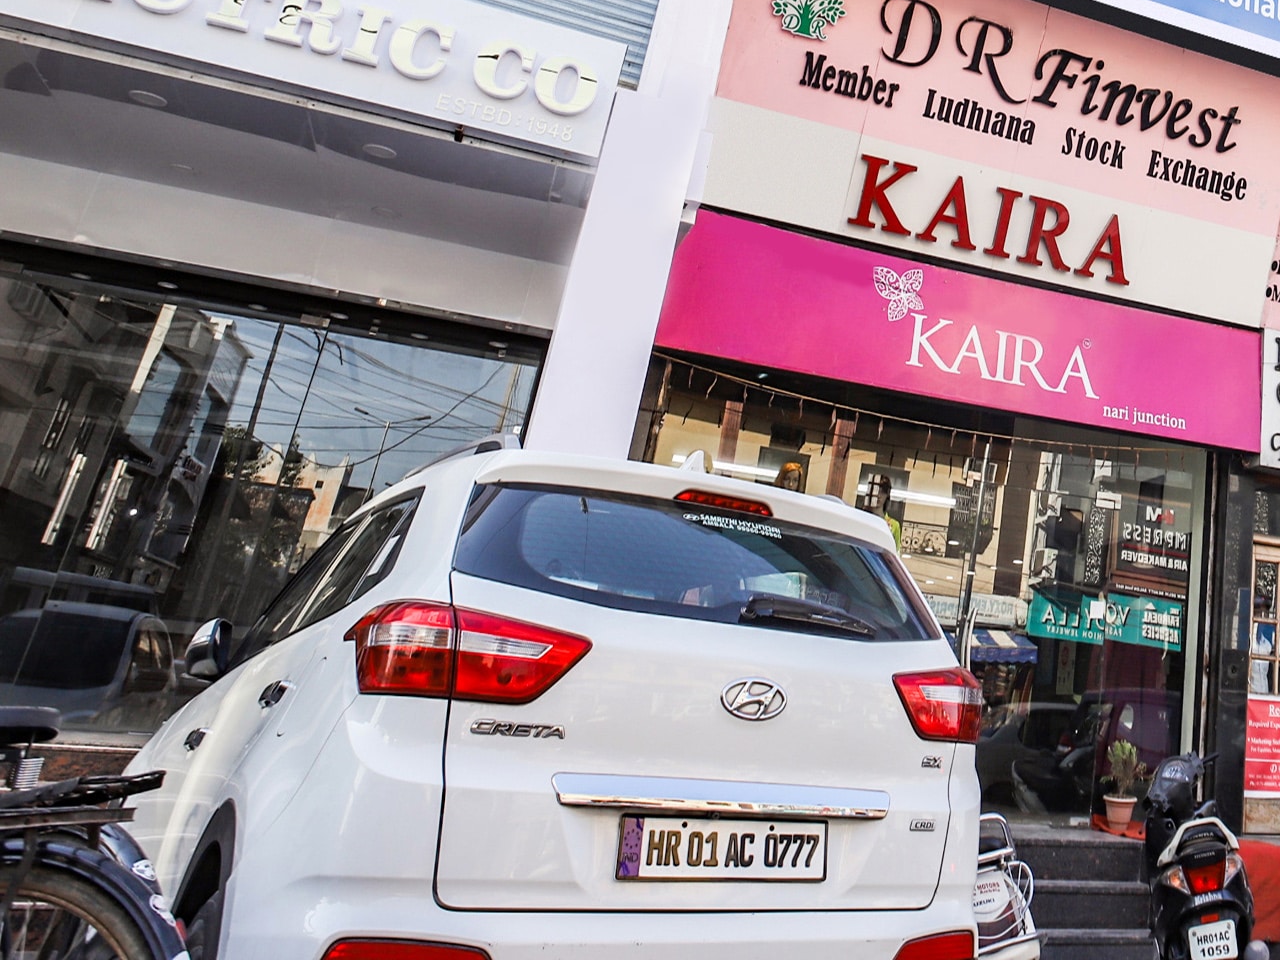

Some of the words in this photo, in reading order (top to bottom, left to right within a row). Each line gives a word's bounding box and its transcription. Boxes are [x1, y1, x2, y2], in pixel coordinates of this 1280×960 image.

[473, 44, 598, 117] CO
[1032, 48, 1242, 154] Finvest
[799, 50, 900, 108] Member
[922, 88, 1036, 145] Ludhiana
[1061, 125, 1127, 170] Stock
[1146, 149, 1247, 201] Exchange
[847, 153, 1131, 287] KAIRA
[905, 312, 1100, 401] KAIRA
[1102, 405, 1130, 421] nari
[1131, 407, 1187, 430] junction
[702, 519, 734, 530] AMBALA
[738, 520, 781, 535] HYUNDAI
[470, 718, 566, 740] CRETA
[646, 829, 682, 867] HR
[686, 831, 719, 867] 01
[724, 833, 755, 868] AC
[763, 833, 820, 869] 0777
[977, 881, 1000, 890] MOTORS
[1196, 930, 1230, 947] HR01AC
[1200, 944, 1230, 958] 1059
